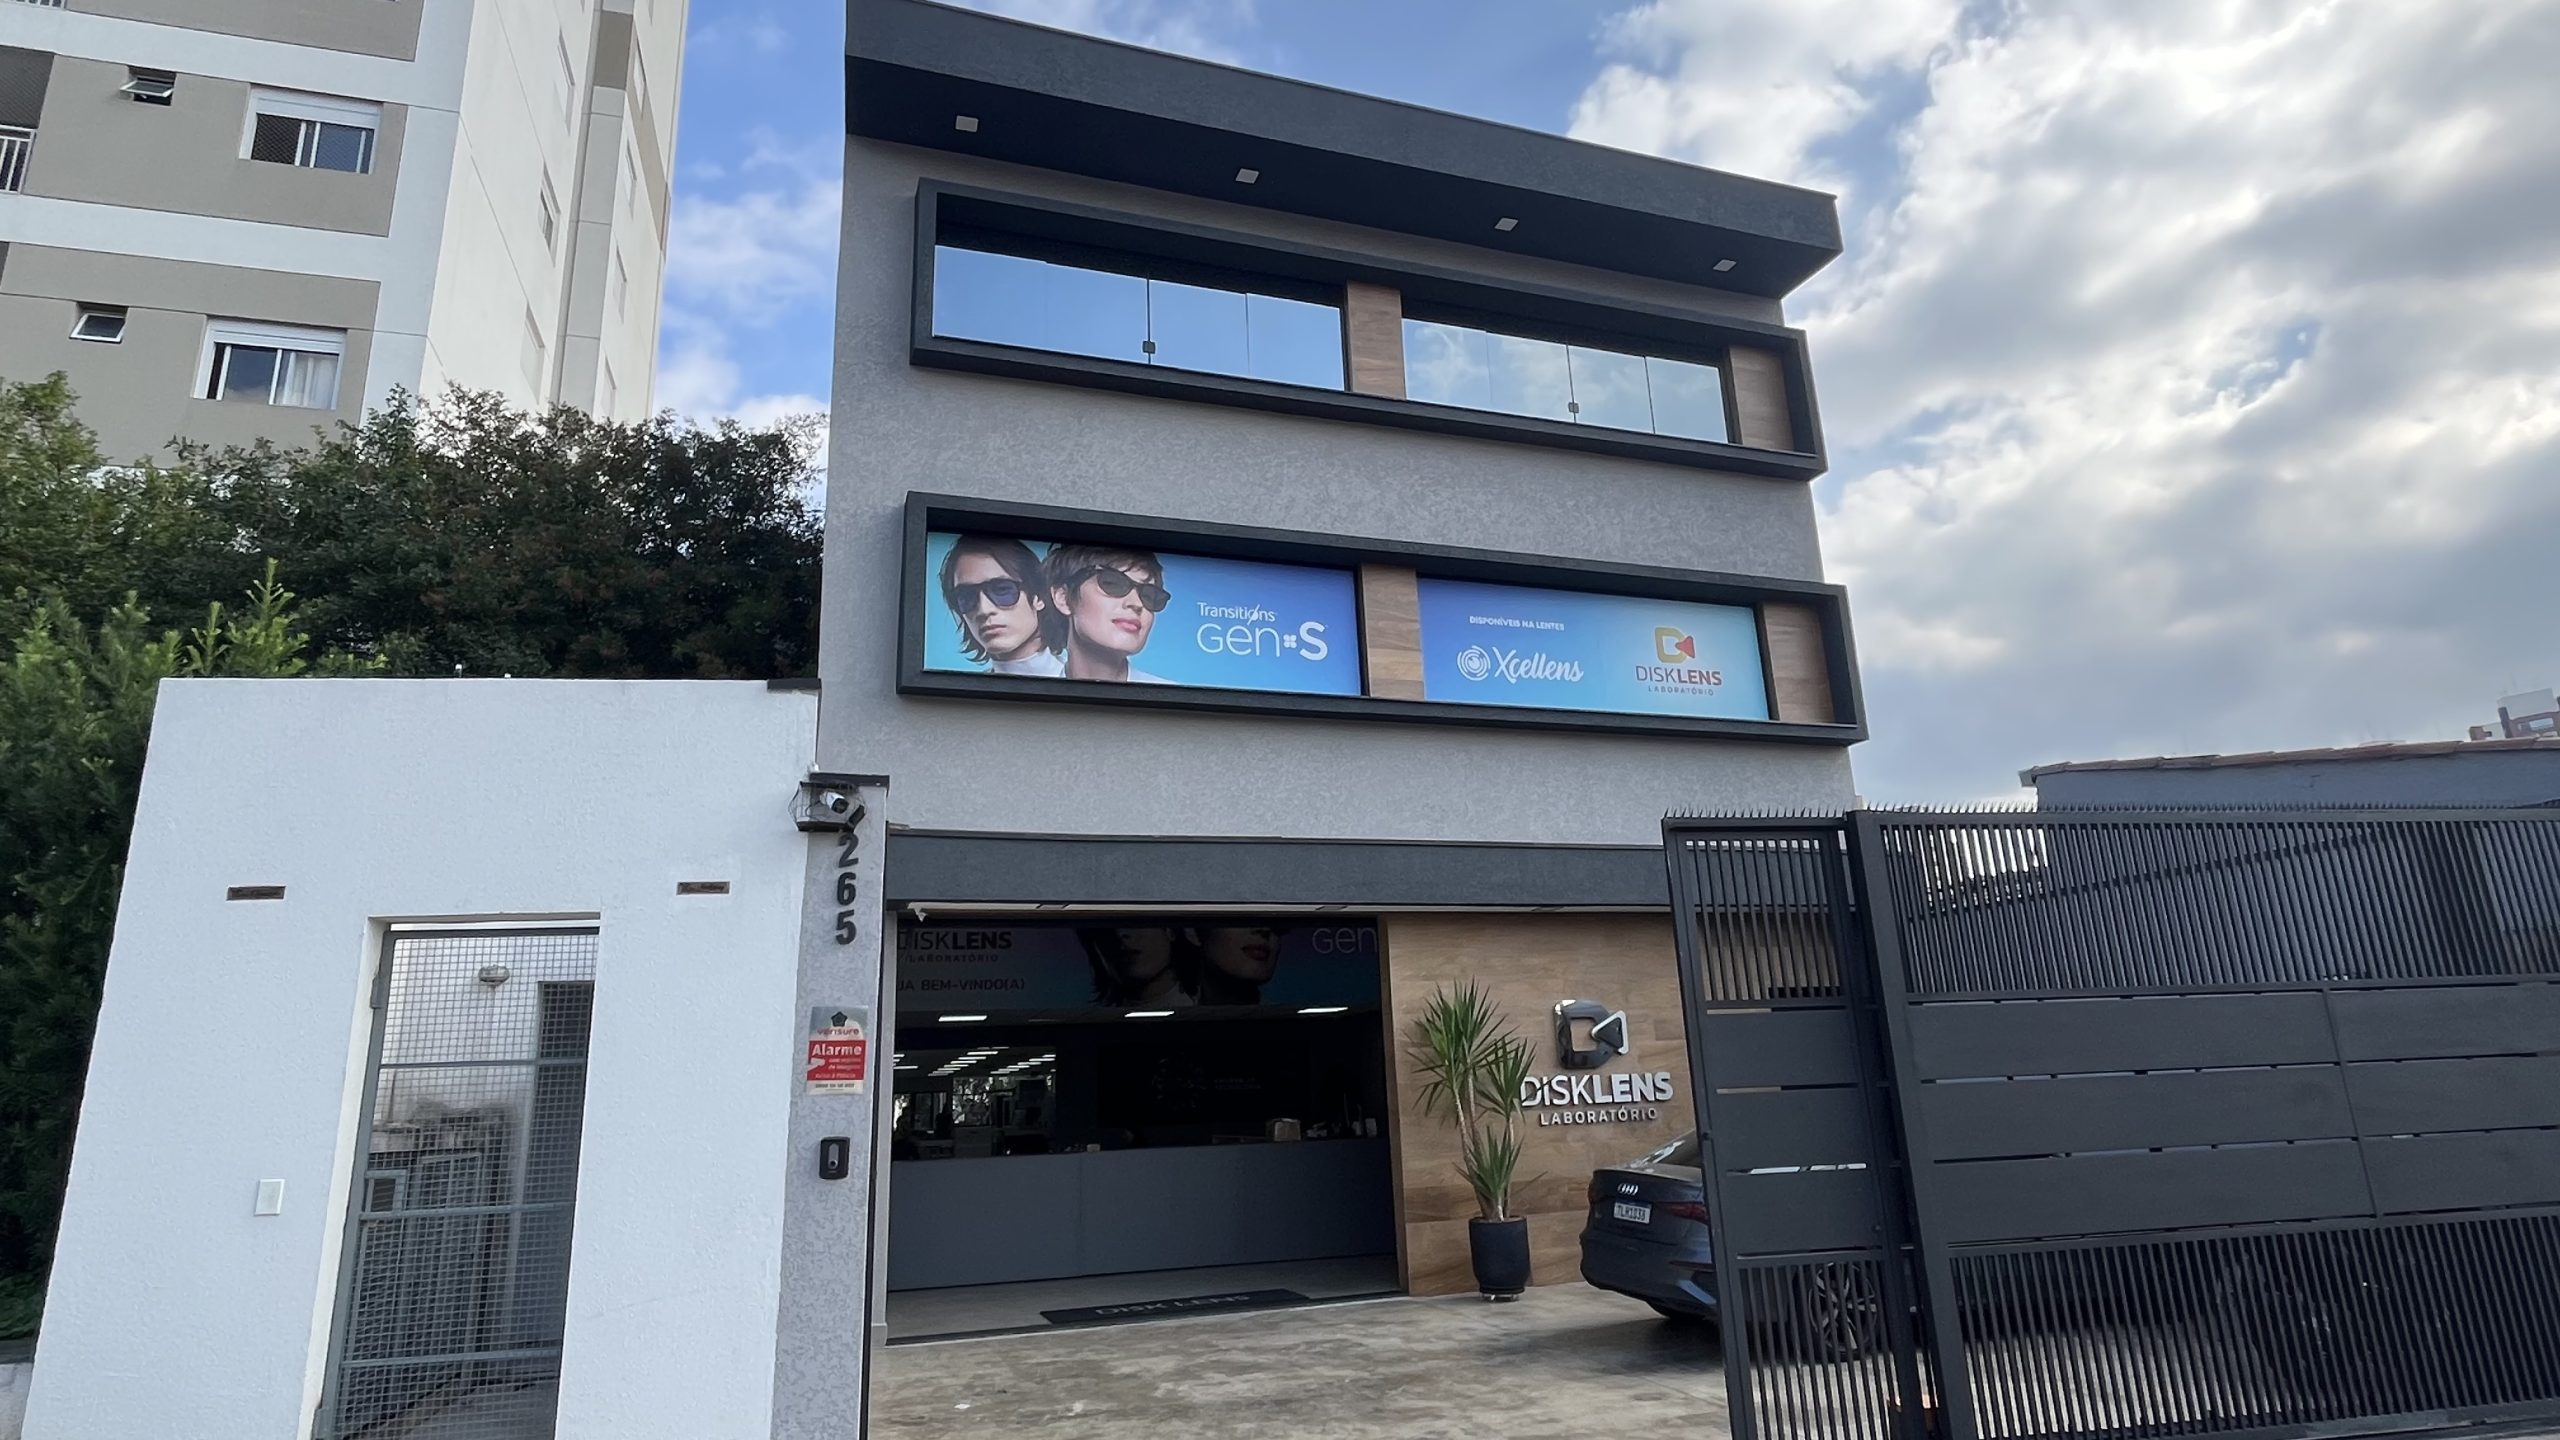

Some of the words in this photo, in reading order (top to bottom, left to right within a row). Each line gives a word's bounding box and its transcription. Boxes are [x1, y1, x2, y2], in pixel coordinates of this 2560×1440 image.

[1196, 602, 1277, 624] Transitions
[1522, 619, 1535, 629] NA
[1536, 621, 1565, 631] LENTES
[1197, 623, 1280, 657] Gen
[1492, 646, 1584, 684] Xcellens
[1635, 665, 1722, 686] DISKLENS
[1648, 685, 1714, 696] LABORATÓRIO
[1312, 927, 1377, 953] Gen
[812, 1043, 862, 1056] Alarme
[1520, 1071, 1674, 1107] DISKLENS
[1540, 1106, 1658, 1126] LABORATÓRIO
